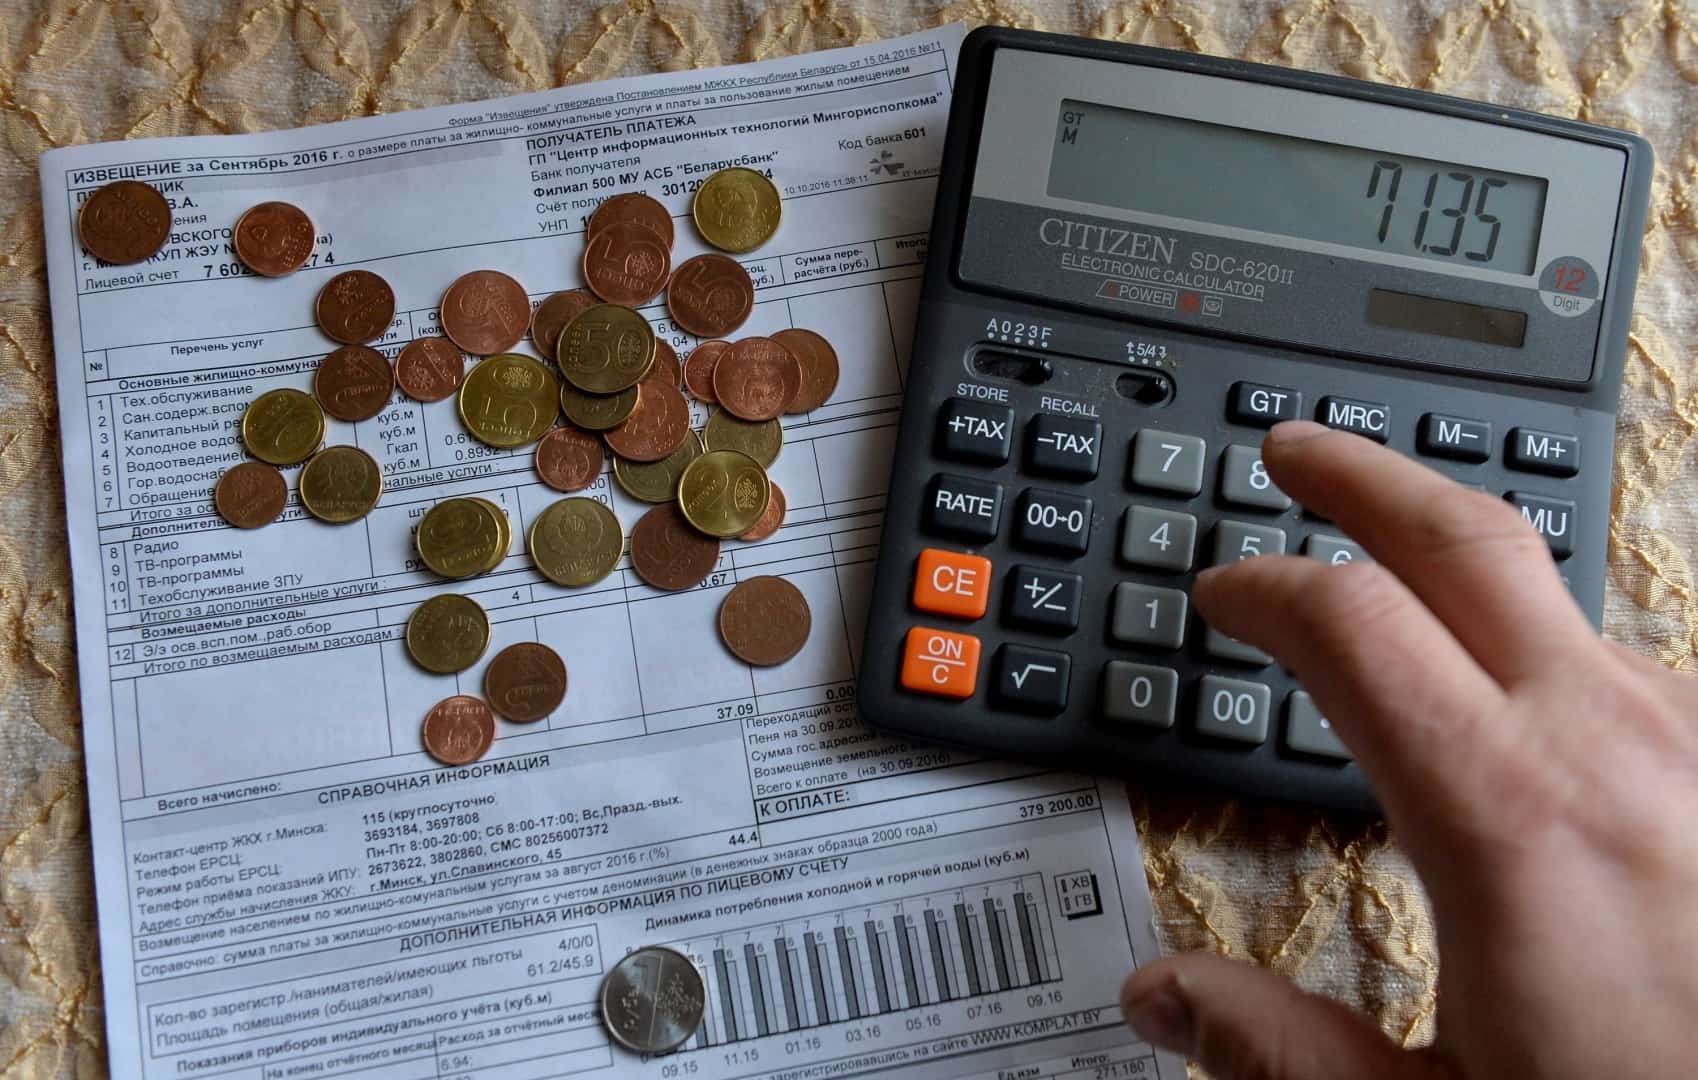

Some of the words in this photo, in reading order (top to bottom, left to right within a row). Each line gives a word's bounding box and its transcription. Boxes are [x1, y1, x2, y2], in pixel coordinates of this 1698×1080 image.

[447, 115, 483, 129] Форма
[704, 77, 738, 91] МЖКХ
[73, 162, 182, 182] ИЗВЕЩЕНИЕ
[187, 162, 205, 172] за
[210, 155, 289, 172] Сентябрь
[293, 151, 328, 165] 2016
[358, 143, 407, 161] размере
[411, 137, 447, 150] платы
[527, 112, 612, 132] коммунальные
[720, 84, 793, 103] пользование
[838, 65, 911, 83] помещением
[529, 151, 547, 165] ГП
[550, 146, 599, 163] "Центр
[602, 126, 728, 154] информационных
[731, 112, 809, 136] технологий
[813, 90, 944, 123] Мингорисполкома"
[1063, 111, 1085, 125] GT
[526, 125, 623, 150] ПОЛУЧАТЕЛЬ
[627, 114, 696, 135] ПЛАТЕЖА
[838, 139, 863, 151] Код
[866, 133, 903, 147] банка
[904, 126, 927, 140] 601
[1062, 127, 1078, 145] M
[531, 169, 563, 182] Банк
[566, 156, 641, 176] получателя
[533, 180, 589, 201] Филиал
[592, 174, 616, 189] 500
[619, 170, 639, 184] МУ
[643, 164, 674, 180] АСБ
[676, 147, 779, 175] "Беларусбанк"
[536, 199, 568, 213] Счёт
[538, 217, 569, 232] УНП
[184, 244, 218, 258] ЖЭУ
[1040, 218, 1178, 264] CITIZEN
[85, 272, 144, 290] Лицевой
[149, 271, 179, 282] счет
[1061, 253, 1160, 281] ELECTRONIC
[1163, 270, 1265, 298] CALCULATOR
[1553, 265, 1585, 293] 12
[1119, 284, 1174, 306] POWER
[1553, 296, 1580, 312] Digit
[987, 318, 998, 331] A
[170, 343, 228, 357] Перечень
[231, 338, 265, 352] услуг
[118, 375, 189, 390] Основные
[957, 382, 1009, 402] STORE
[121, 387, 253, 408] Тех.обслуживание
[1040, 396, 1100, 418] RECALL
[1249, 390, 1288, 416] GT
[98, 415, 108, 428] 2
[377, 412, 414, 426] куб.м
[1328, 401, 1385, 432] MRC
[100, 433, 109, 444] 3
[123, 419, 219, 444] Капитальный
[379, 427, 416, 441] куб.м
[949, 415, 1006, 441] +TAX
[101, 448, 110, 460] 4
[125, 440, 197, 458] Холодное
[386, 445, 417, 454] Гкал
[1160, 443, 1182, 473] 7
[102, 465, 111, 477] 5
[384, 458, 421, 472] куб.м
[103, 481, 112, 492] 6
[130, 509, 171, 521] Итого
[176, 506, 192, 516] за
[935, 489, 995, 518] RATE
[1521, 506, 1567, 537] MU
[1150, 522, 1171, 551] 4
[109, 548, 119, 559] 8
[133, 542, 180, 555] Радио
[111, 565, 121, 577] 9
[135, 552, 243, 573] ТВ-программы
[110, 582, 126, 594] 10
[136, 569, 245, 588] ТВ-программы
[931, 565, 978, 597] CE
[139, 582, 270, 605] Техобслуживание
[140, 610, 182, 623] Итого
[186, 607, 202, 616] за
[206, 592, 329, 616] дополнительные
[333, 584, 379, 599] услуги
[141, 619, 243, 639] Возмещаемые
[247, 609, 307, 627] расходы
[1145, 598, 1159, 630] 1
[115, 650, 131, 662] 12
[143, 661, 186, 674] Итого
[190, 658, 209, 668] по
[213, 642, 319, 664] возмещаемым
[323, 631, 393, 650] расходам
[927, 636, 963, 659] ON
[931, 664, 949, 685] C
[1130, 676, 1153, 708] 0
[716, 704, 755, 719] 37.09
[745, 707, 832, 728] Переходящий
[1212, 689, 1257, 726] 00
[748, 734, 780, 745] Пеня
[751, 748, 794, 763] Сумма
[753, 757, 834, 778] Возмещение
[317, 775, 431, 805] СПРАВОЧНАЯ
[435, 755, 550, 785] ИНФОРМАЦИЯ
[756, 783, 793, 795] Всего
[806, 772, 849, 785] оплате
[157, 797, 198, 811] Всего
[202, 781, 283, 804] начислено:
[760, 805, 771, 817] К
[776, 793, 851, 814] ОПЛАТЕ:
[1019, 805, 1046, 819] 379
[1048, 796, 1094, 813] 200.00
[362, 812, 385, 825] 115
[426, 812, 480, 832] 3697808
[366, 845, 406, 860] Пн-Пт
[486, 825, 504, 837] Сб
[490, 839, 521, 854] СМС
[526, 824, 609, 848] 80256007372
[728, 831, 758, 845] 44.4
[872, 829, 902, 845] 2000
[132, 843, 228, 865] Контакт-центр
[547, 849, 563, 861] 45
[134, 865, 196, 882] Телефон
[185, 875, 235, 892] работы
[1071, 877, 1089, 889] ХВ
[646, 910, 711, 933] Динамика
[716, 892, 803, 917] потребления
[807, 878, 872, 901] холодной
[985, 847, 1030, 869] (куб.м)
[1074, 894, 1092, 907] ГВ
[138, 899, 200, 916] Телефон
[139, 931, 225, 953] Возмещение
[230, 917, 310, 937] населением
[605, 854, 636, 869] 2016
[239, 894, 319, 915] начисления
[400, 910, 556, 953] ДОПОЛНИТЕЛЬНАЯ
[562, 889, 674, 922] ИНФОРМАЦИЯ
[680, 885, 703, 900] ПО
[708, 869, 793, 894] ЛИЦЕВОМУ
[232, 1009, 320, 1034] помещения
[177, 1053, 253, 1074] Показания
[257, 1039, 327, 1060] приборов
[331, 1014, 458, 1043] индивидуального
[724, 1049, 760, 1065] 11.15
[661, 1063, 699, 1077] 09.15
